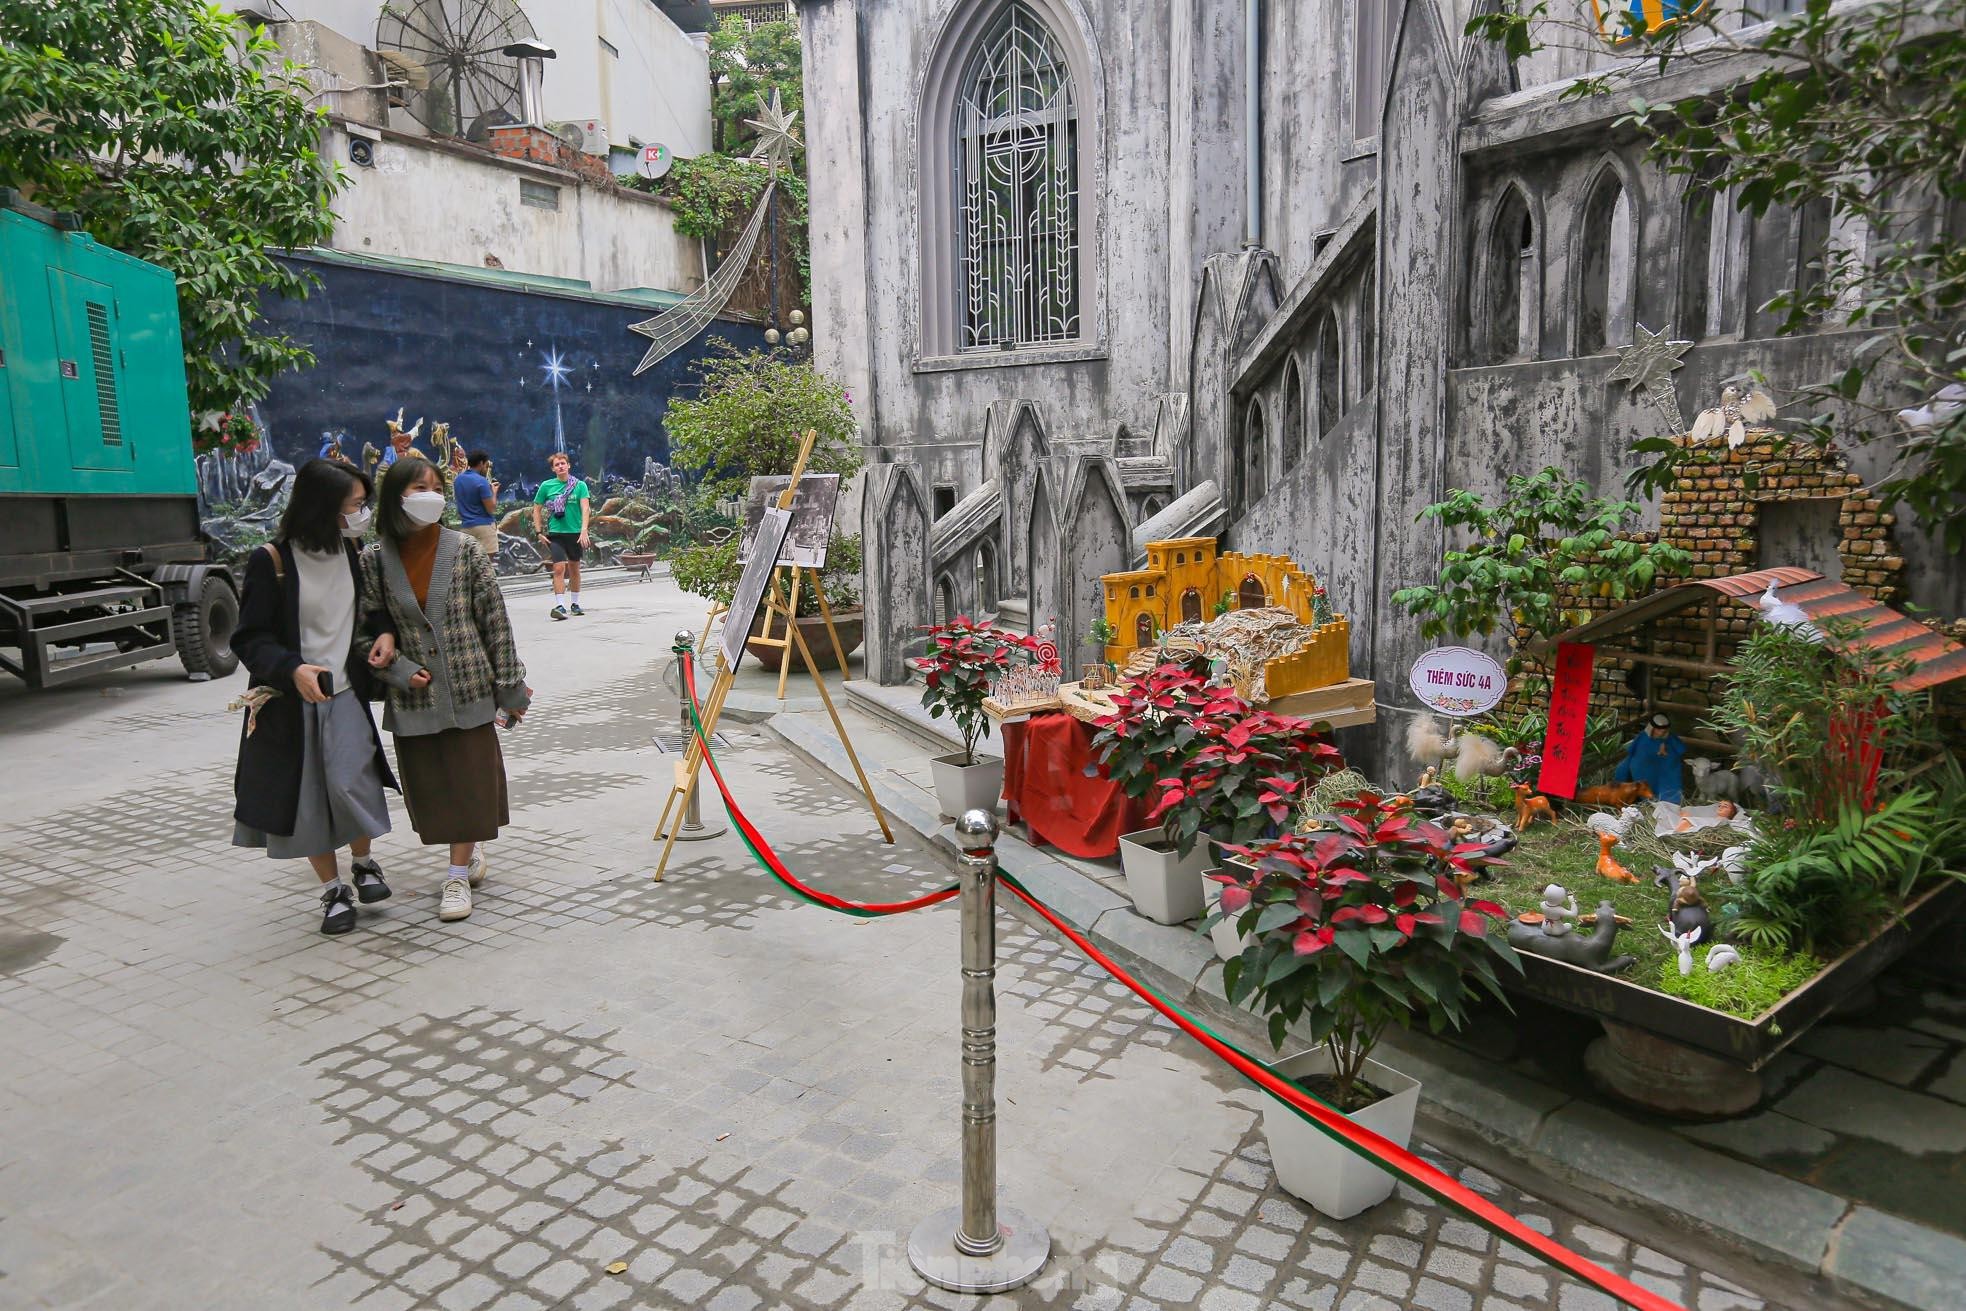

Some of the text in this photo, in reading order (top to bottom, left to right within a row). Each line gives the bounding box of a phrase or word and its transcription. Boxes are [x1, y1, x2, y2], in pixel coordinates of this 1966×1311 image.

[1427, 668, 1491, 690] THÊM SỨC 4A
